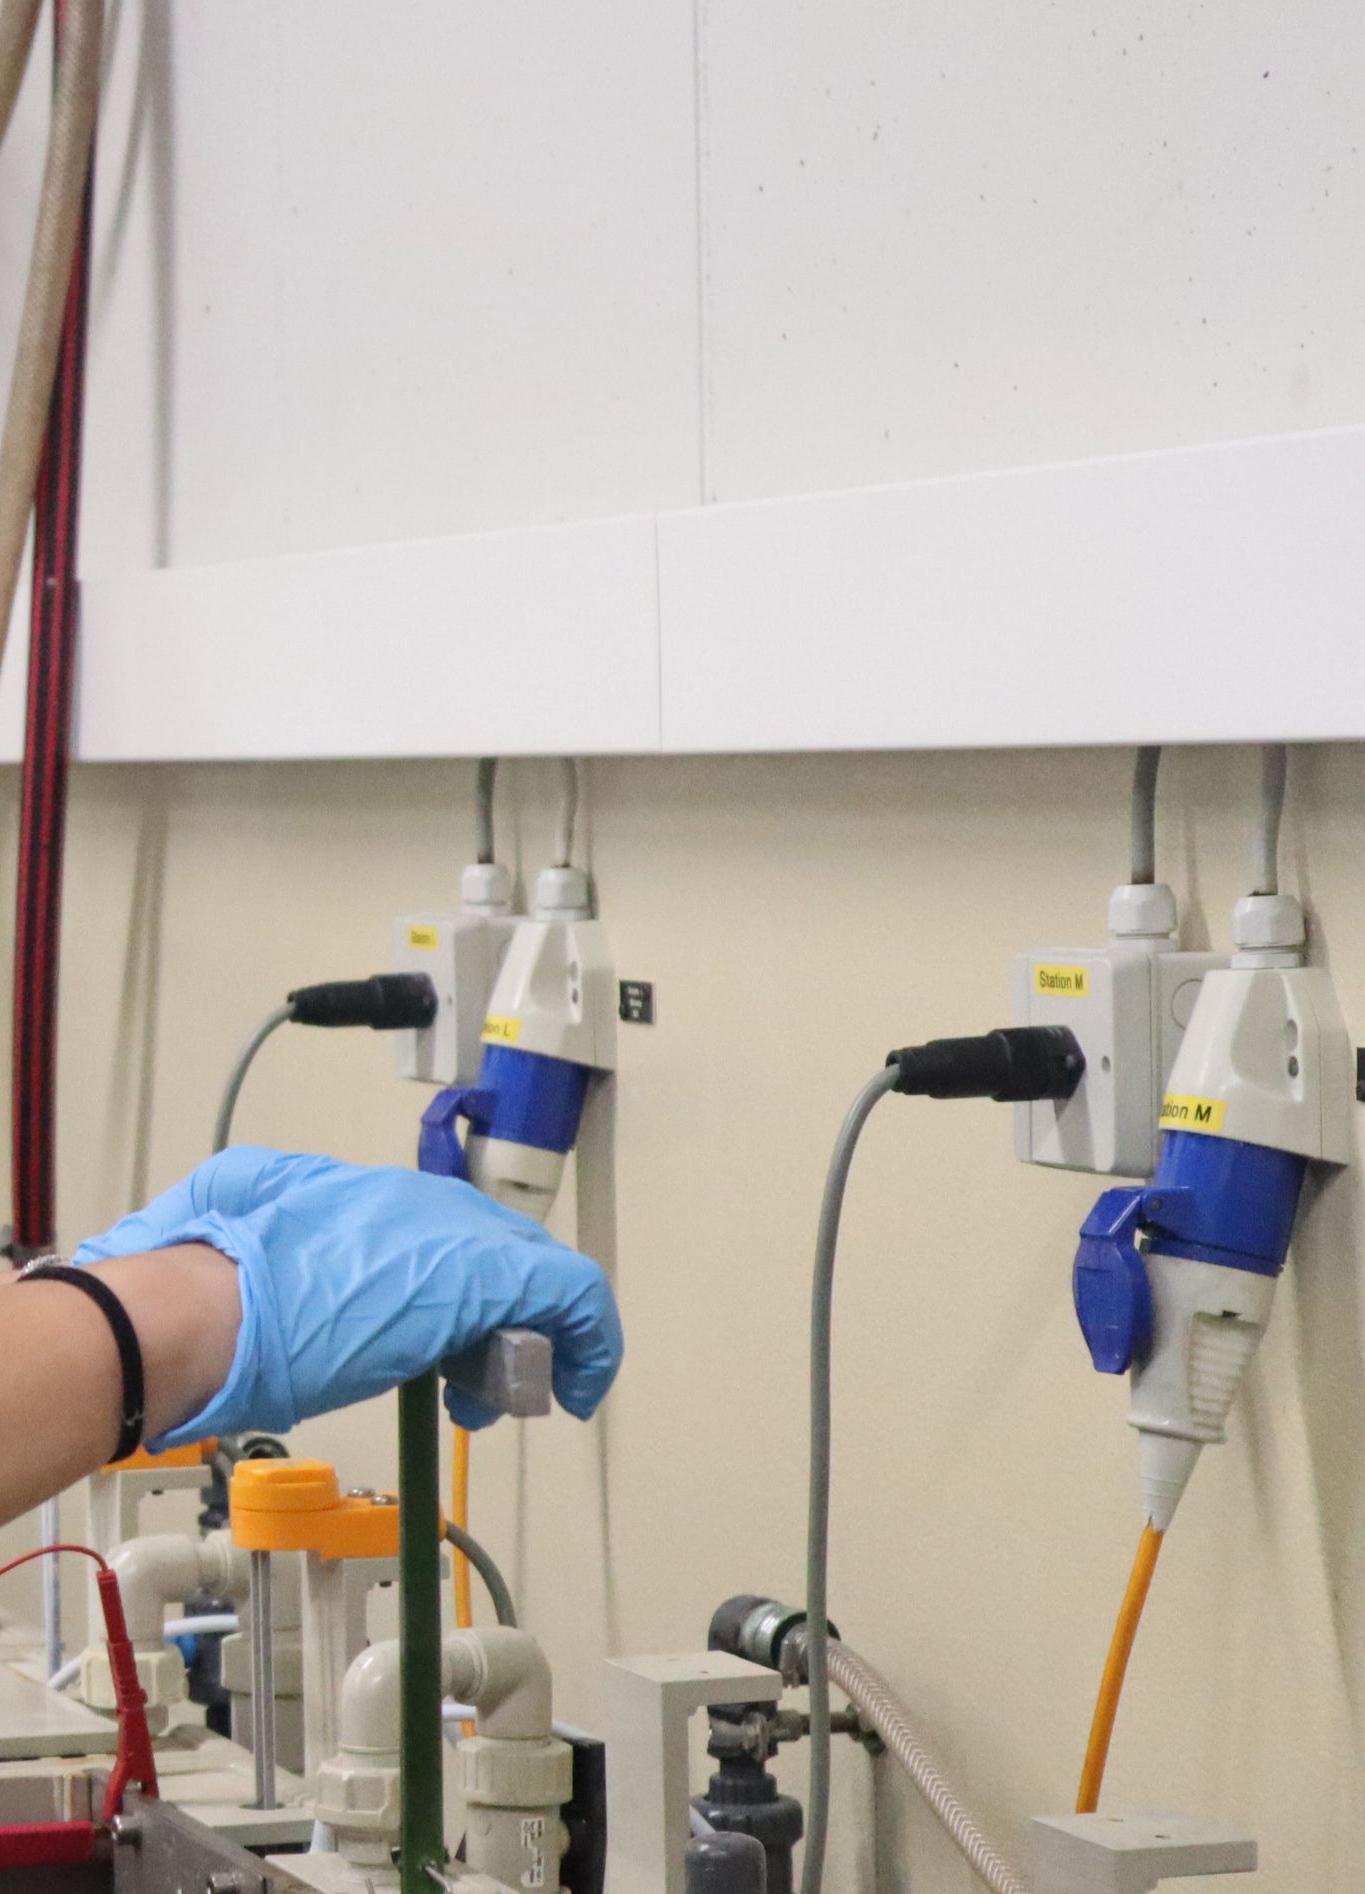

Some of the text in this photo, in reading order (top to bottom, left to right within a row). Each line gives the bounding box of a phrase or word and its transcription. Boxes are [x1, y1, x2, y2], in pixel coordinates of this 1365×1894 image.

[1039, 970, 1084, 991] Station M
[503, 1023, 510, 1037] L
[1194, 1103, 1213, 1123] M
